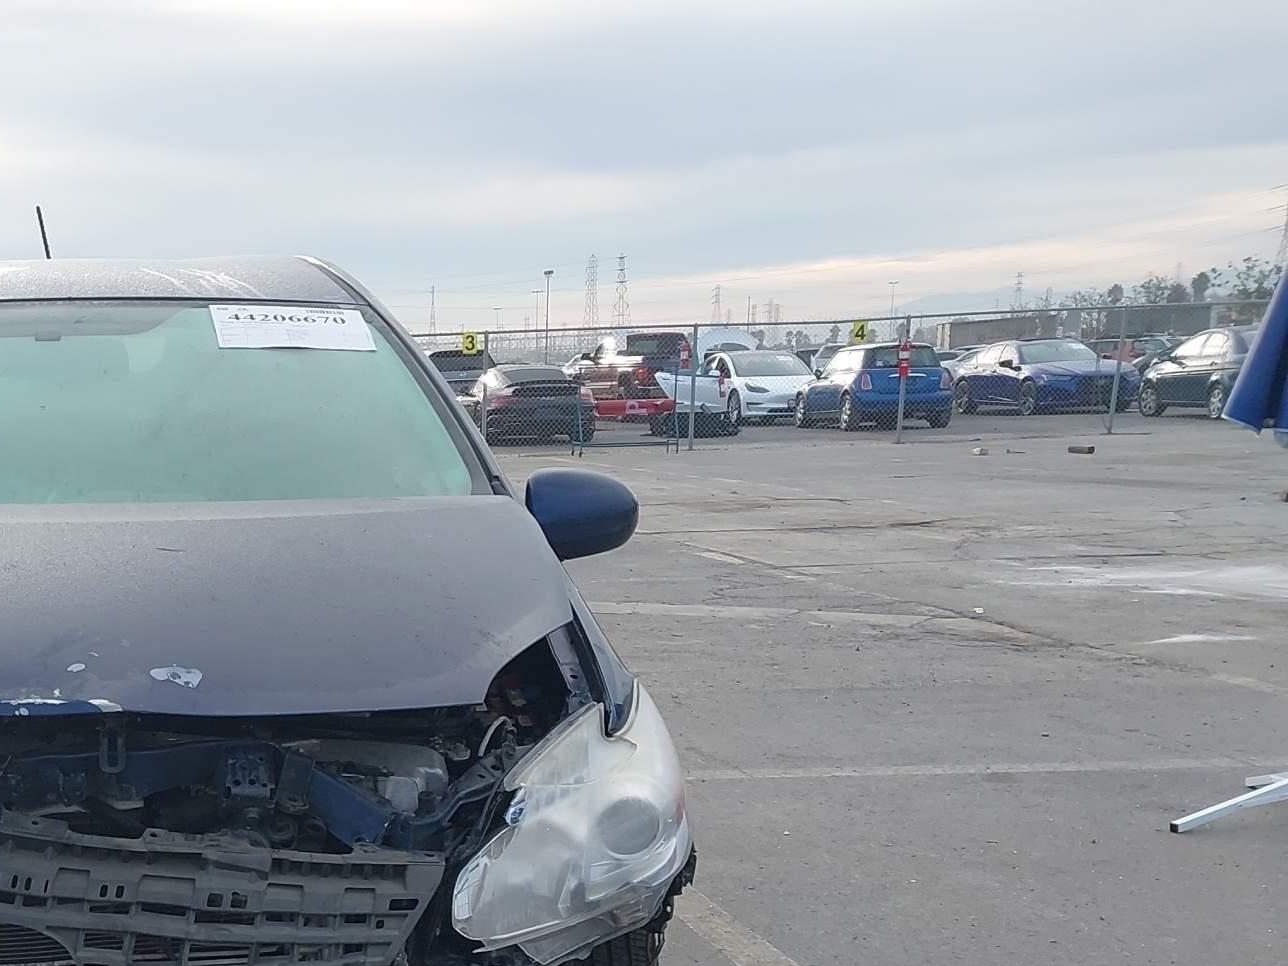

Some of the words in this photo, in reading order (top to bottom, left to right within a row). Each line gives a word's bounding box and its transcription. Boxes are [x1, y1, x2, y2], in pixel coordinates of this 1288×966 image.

[227, 313, 347, 325] 44206670
[854, 324, 866, 340] 4
[465, 334, 476, 351] 3
